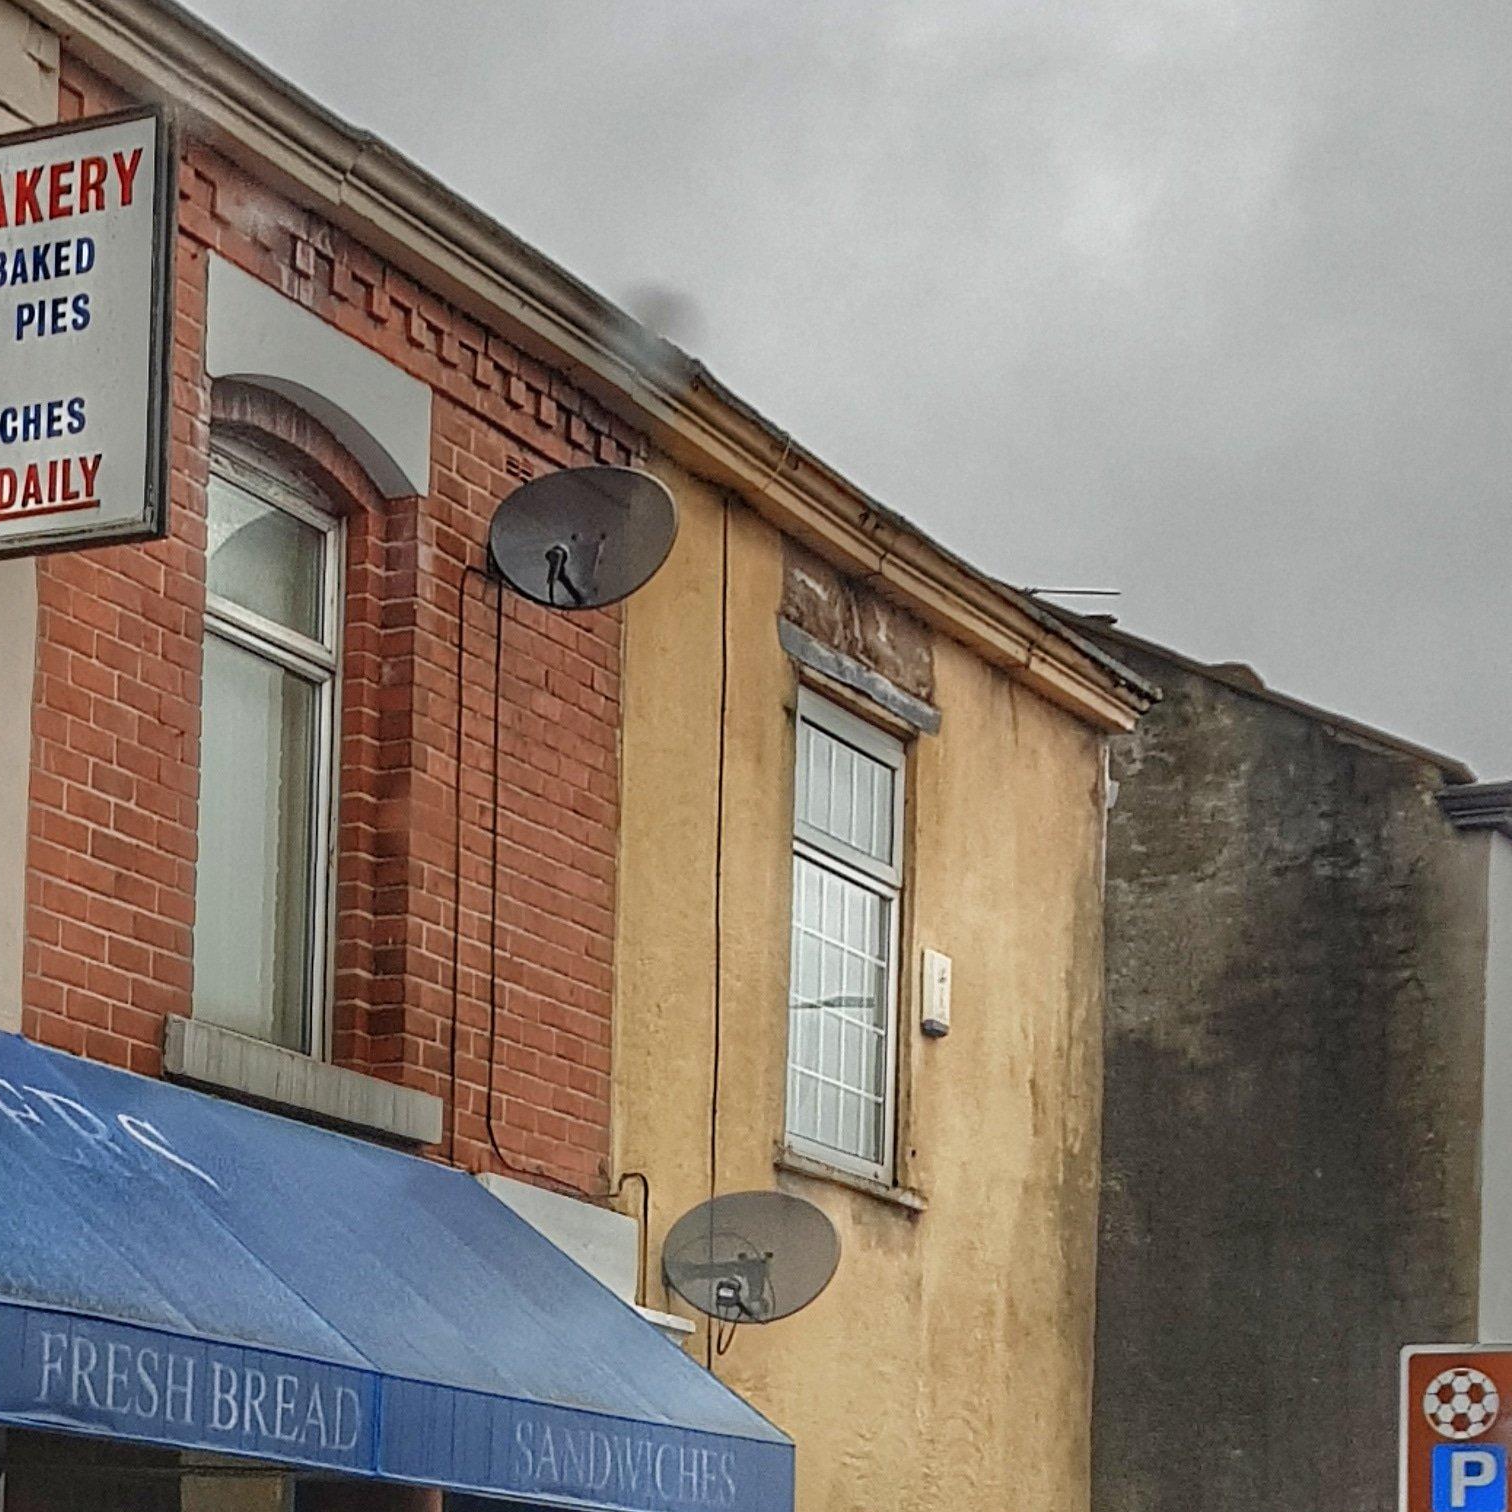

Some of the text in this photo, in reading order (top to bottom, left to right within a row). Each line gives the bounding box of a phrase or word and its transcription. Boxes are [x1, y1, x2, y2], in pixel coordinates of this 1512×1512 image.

[15, 293, 91, 341] PIES
[37, 1329, 361, 1453] FRESH BREAD
[514, 1418, 738, 1503] SANDWICHES
[1451, 1451, 1498, 1507] P
